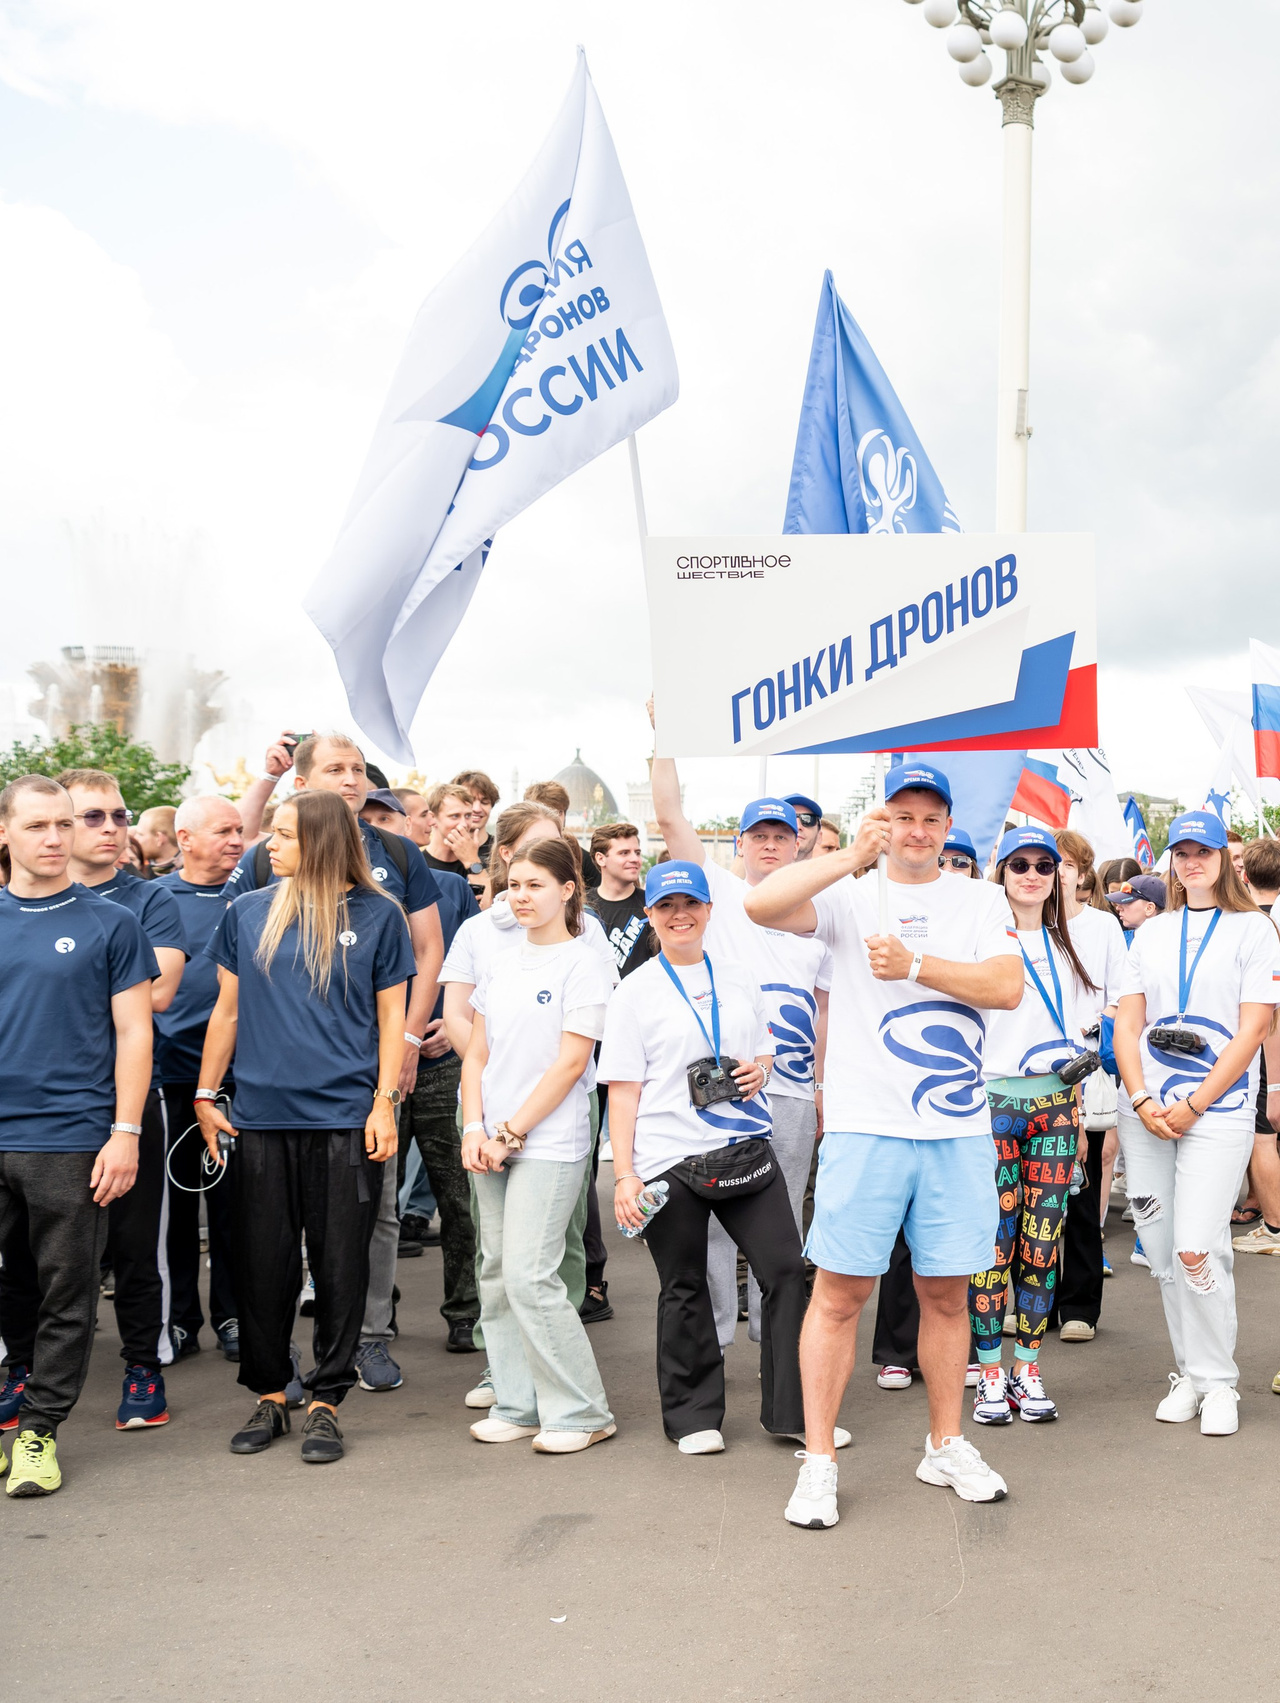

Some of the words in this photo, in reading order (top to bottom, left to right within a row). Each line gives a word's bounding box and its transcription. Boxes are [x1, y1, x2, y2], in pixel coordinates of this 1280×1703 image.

[449, 327, 644, 512] ОССИИ
[676, 554, 792, 570] СПОРТИВНОЕ
[676, 570, 765, 580] ШЕСТВИЕ
[731, 634, 854, 744] ГОНКИ
[864, 553, 1019, 682] ДРОНОВ
[616, 915, 645, 969] EAM
[1052, 1120, 1071, 1128] adidas
[718, 1174, 752, 1188] RUSSIAN
[753, 1161, 773, 1179] RUGBY
